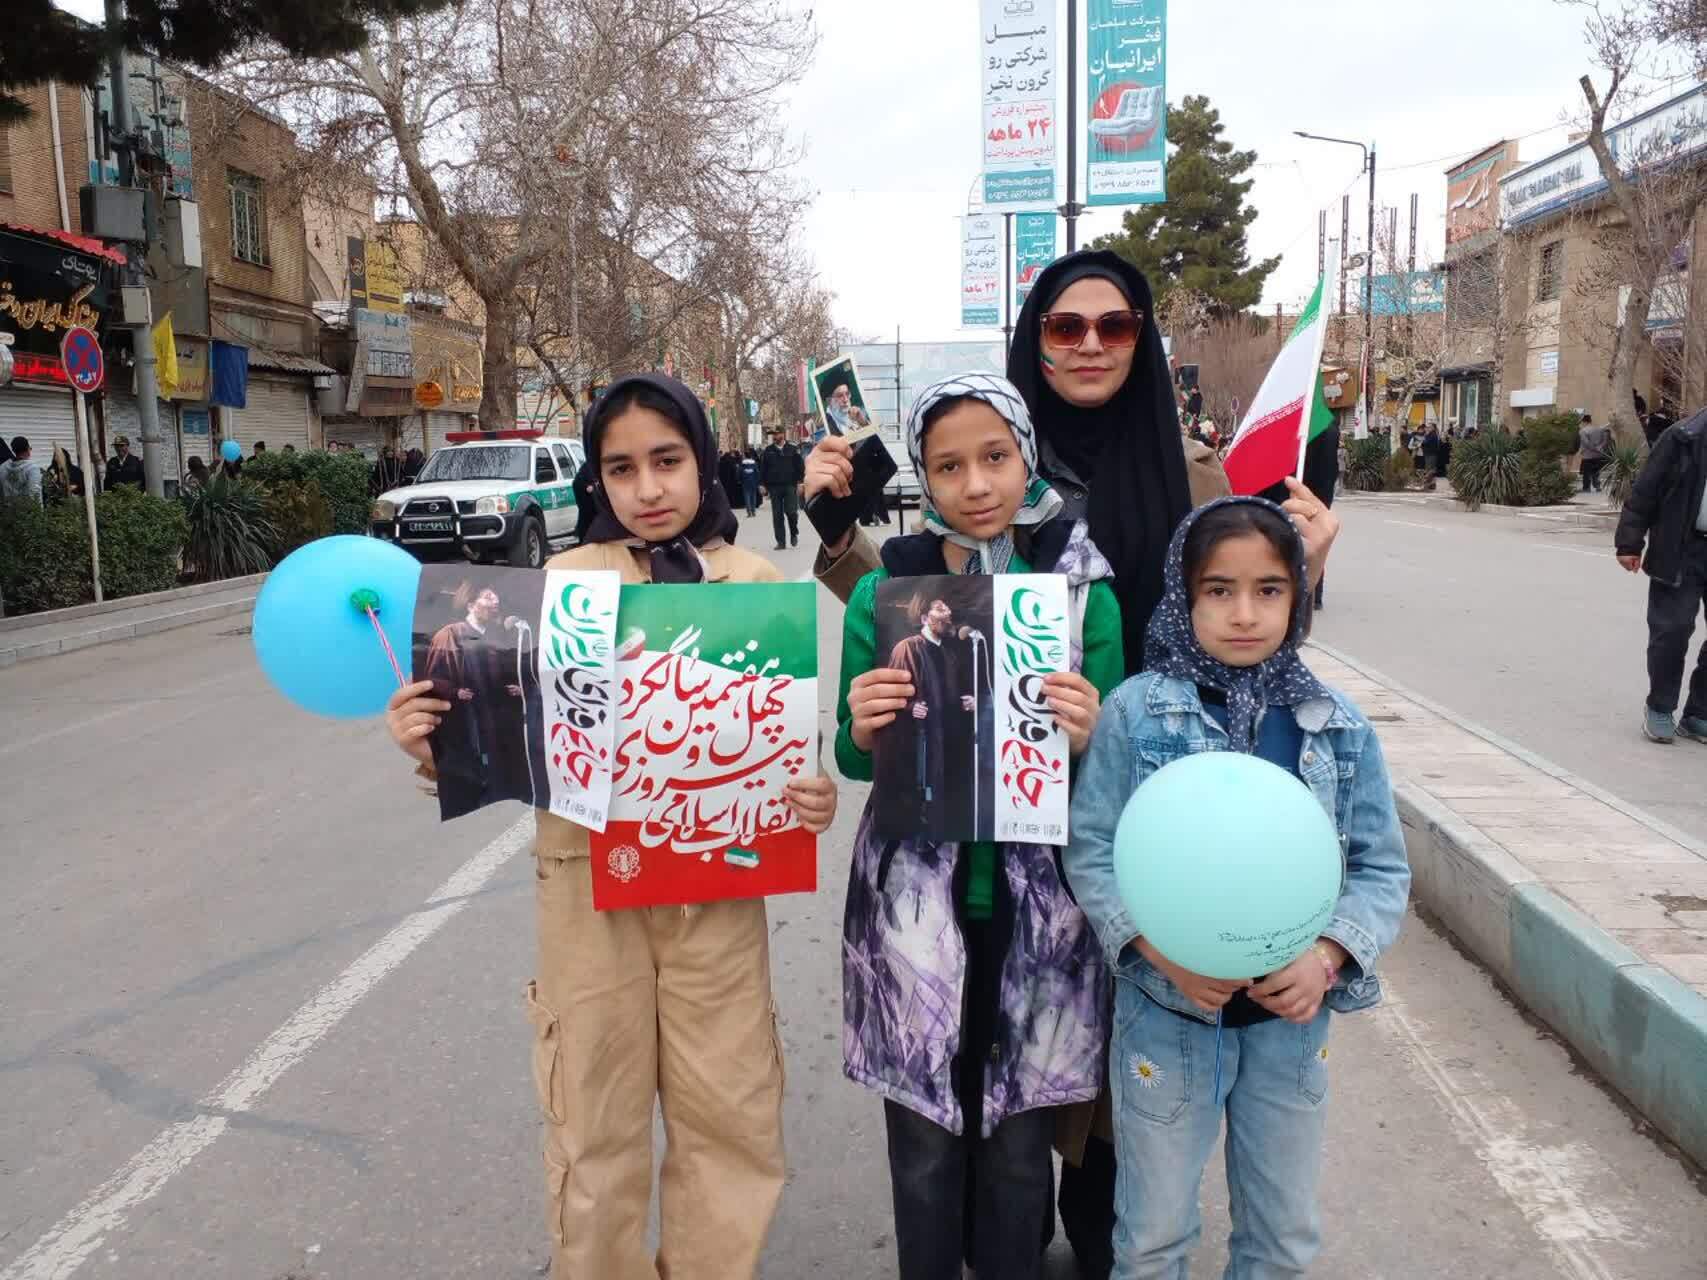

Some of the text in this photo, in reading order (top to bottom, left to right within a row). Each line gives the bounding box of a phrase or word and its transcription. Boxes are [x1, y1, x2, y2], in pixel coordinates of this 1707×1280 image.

[1117, 27, 1161, 48] فخر
[988, 47, 1048, 70] شرکتی رو
[1089, 48, 1161, 75] ایرانیان
[987, 75, 1013, 95] نخر
[988, 117, 1051, 142] ۲۴ ماهه
[545, 583, 612, 668] ایران
[1002, 588, 1064, 677] ایران
[618, 624, 795, 770] چهل و هفتمین سالگرد
[612, 728, 809, 801] پیروزی
[639, 793, 740, 848] اسلامی
